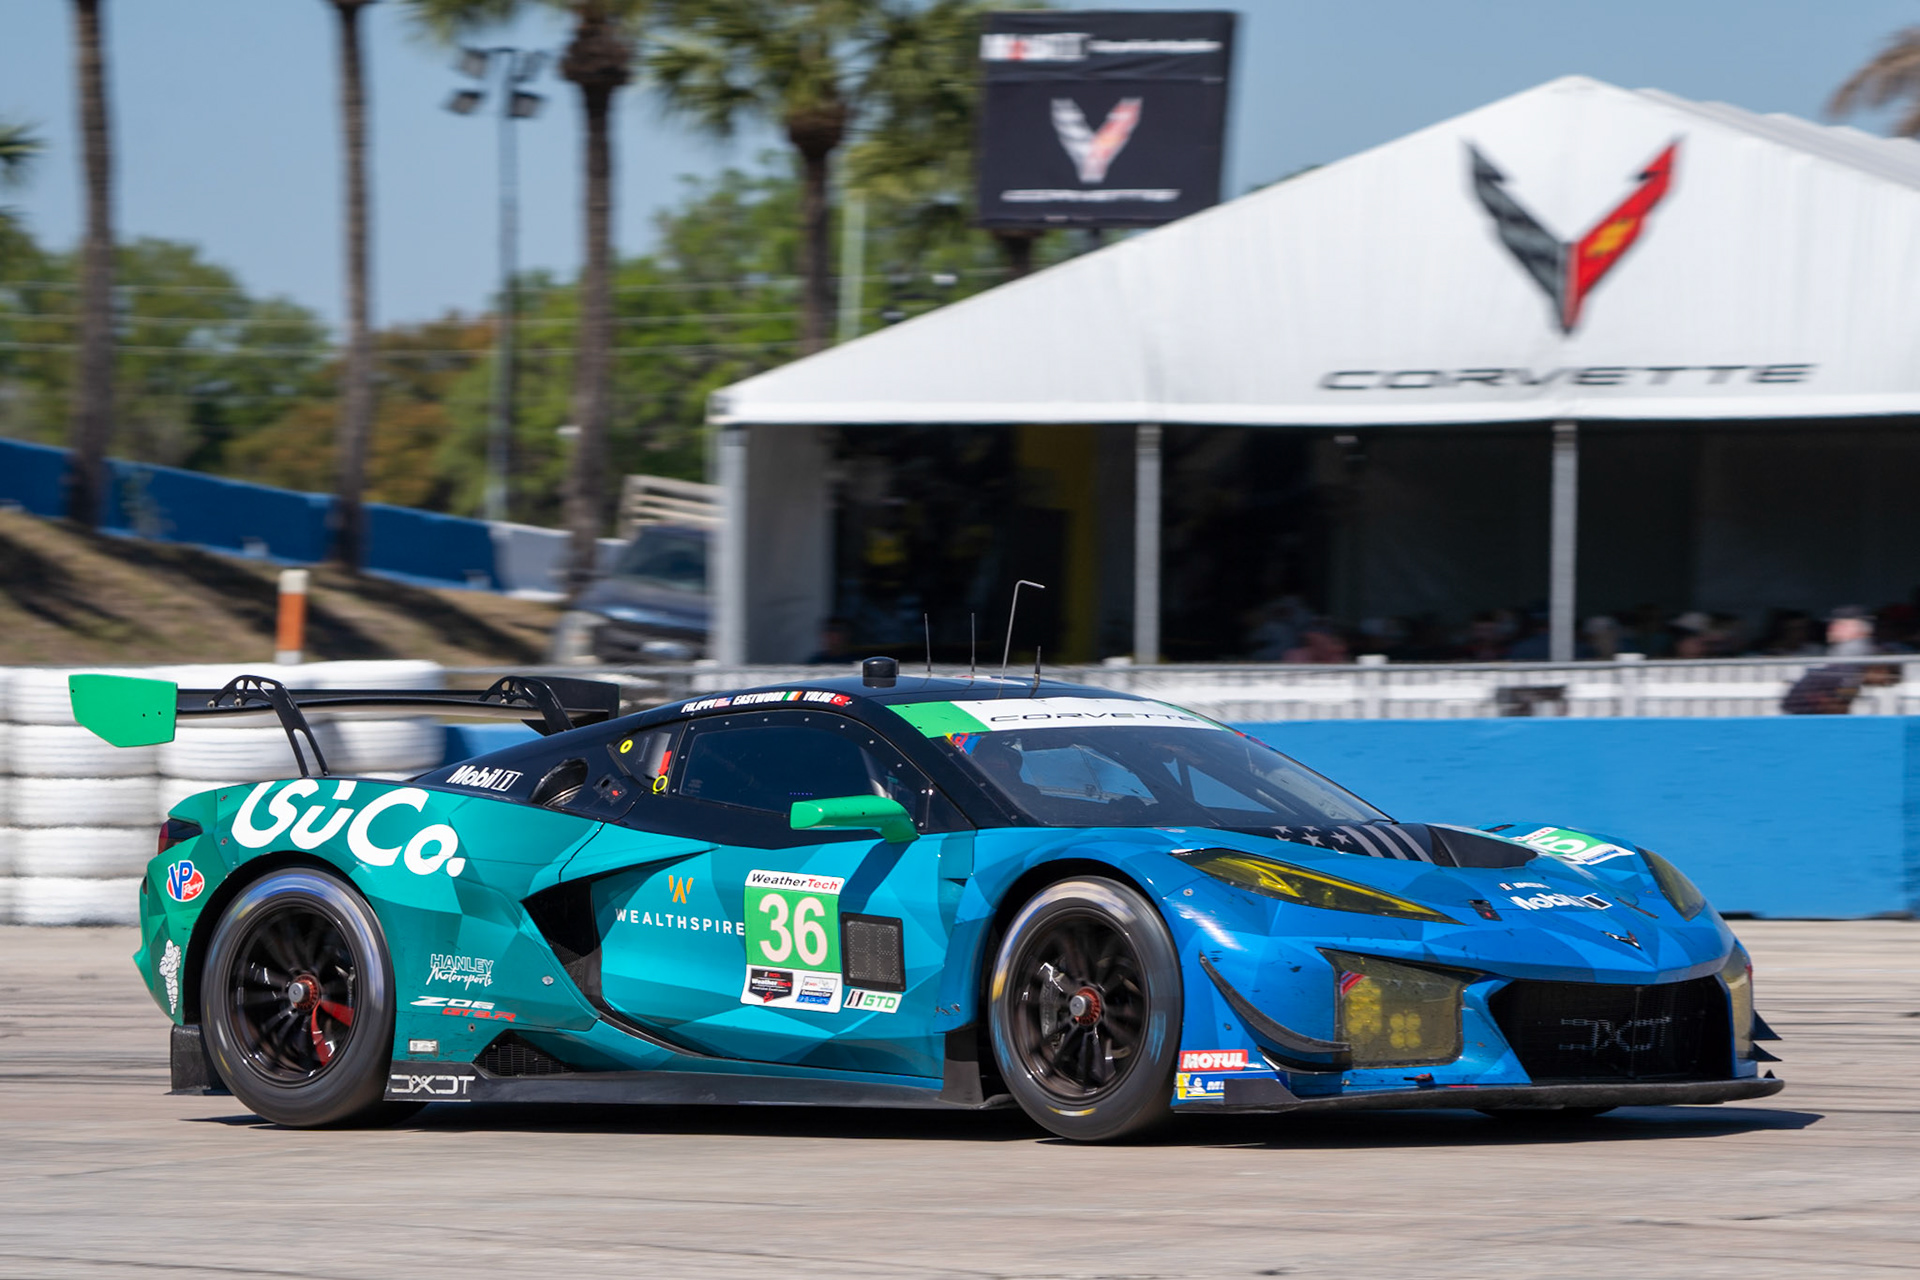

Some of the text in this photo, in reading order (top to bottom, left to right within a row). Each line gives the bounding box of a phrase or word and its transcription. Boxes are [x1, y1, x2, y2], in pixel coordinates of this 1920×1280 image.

[1319, 363, 1818, 390] CORVETTE
[681, 699, 717, 713] FILIPPI
[732, 691, 787, 705] EASTWOOD
[990, 712, 1197, 722] CORVETTE
[446, 765, 503, 788] Mobil
[168, 860, 195, 901] VP
[752, 873, 839, 890] WeatherTech
[615, 908, 745, 936] WEALTHSPIRE
[759, 893, 828, 966] 36
[430, 953, 494, 973] HANLEY
[426, 966, 494, 990] Motorsports
[410, 996, 495, 1010] Z06
[864, 994, 896, 1008] GTD
[442, 1007, 516, 1022] GT3.R
[1182, 1053, 1245, 1068] MOTUL
